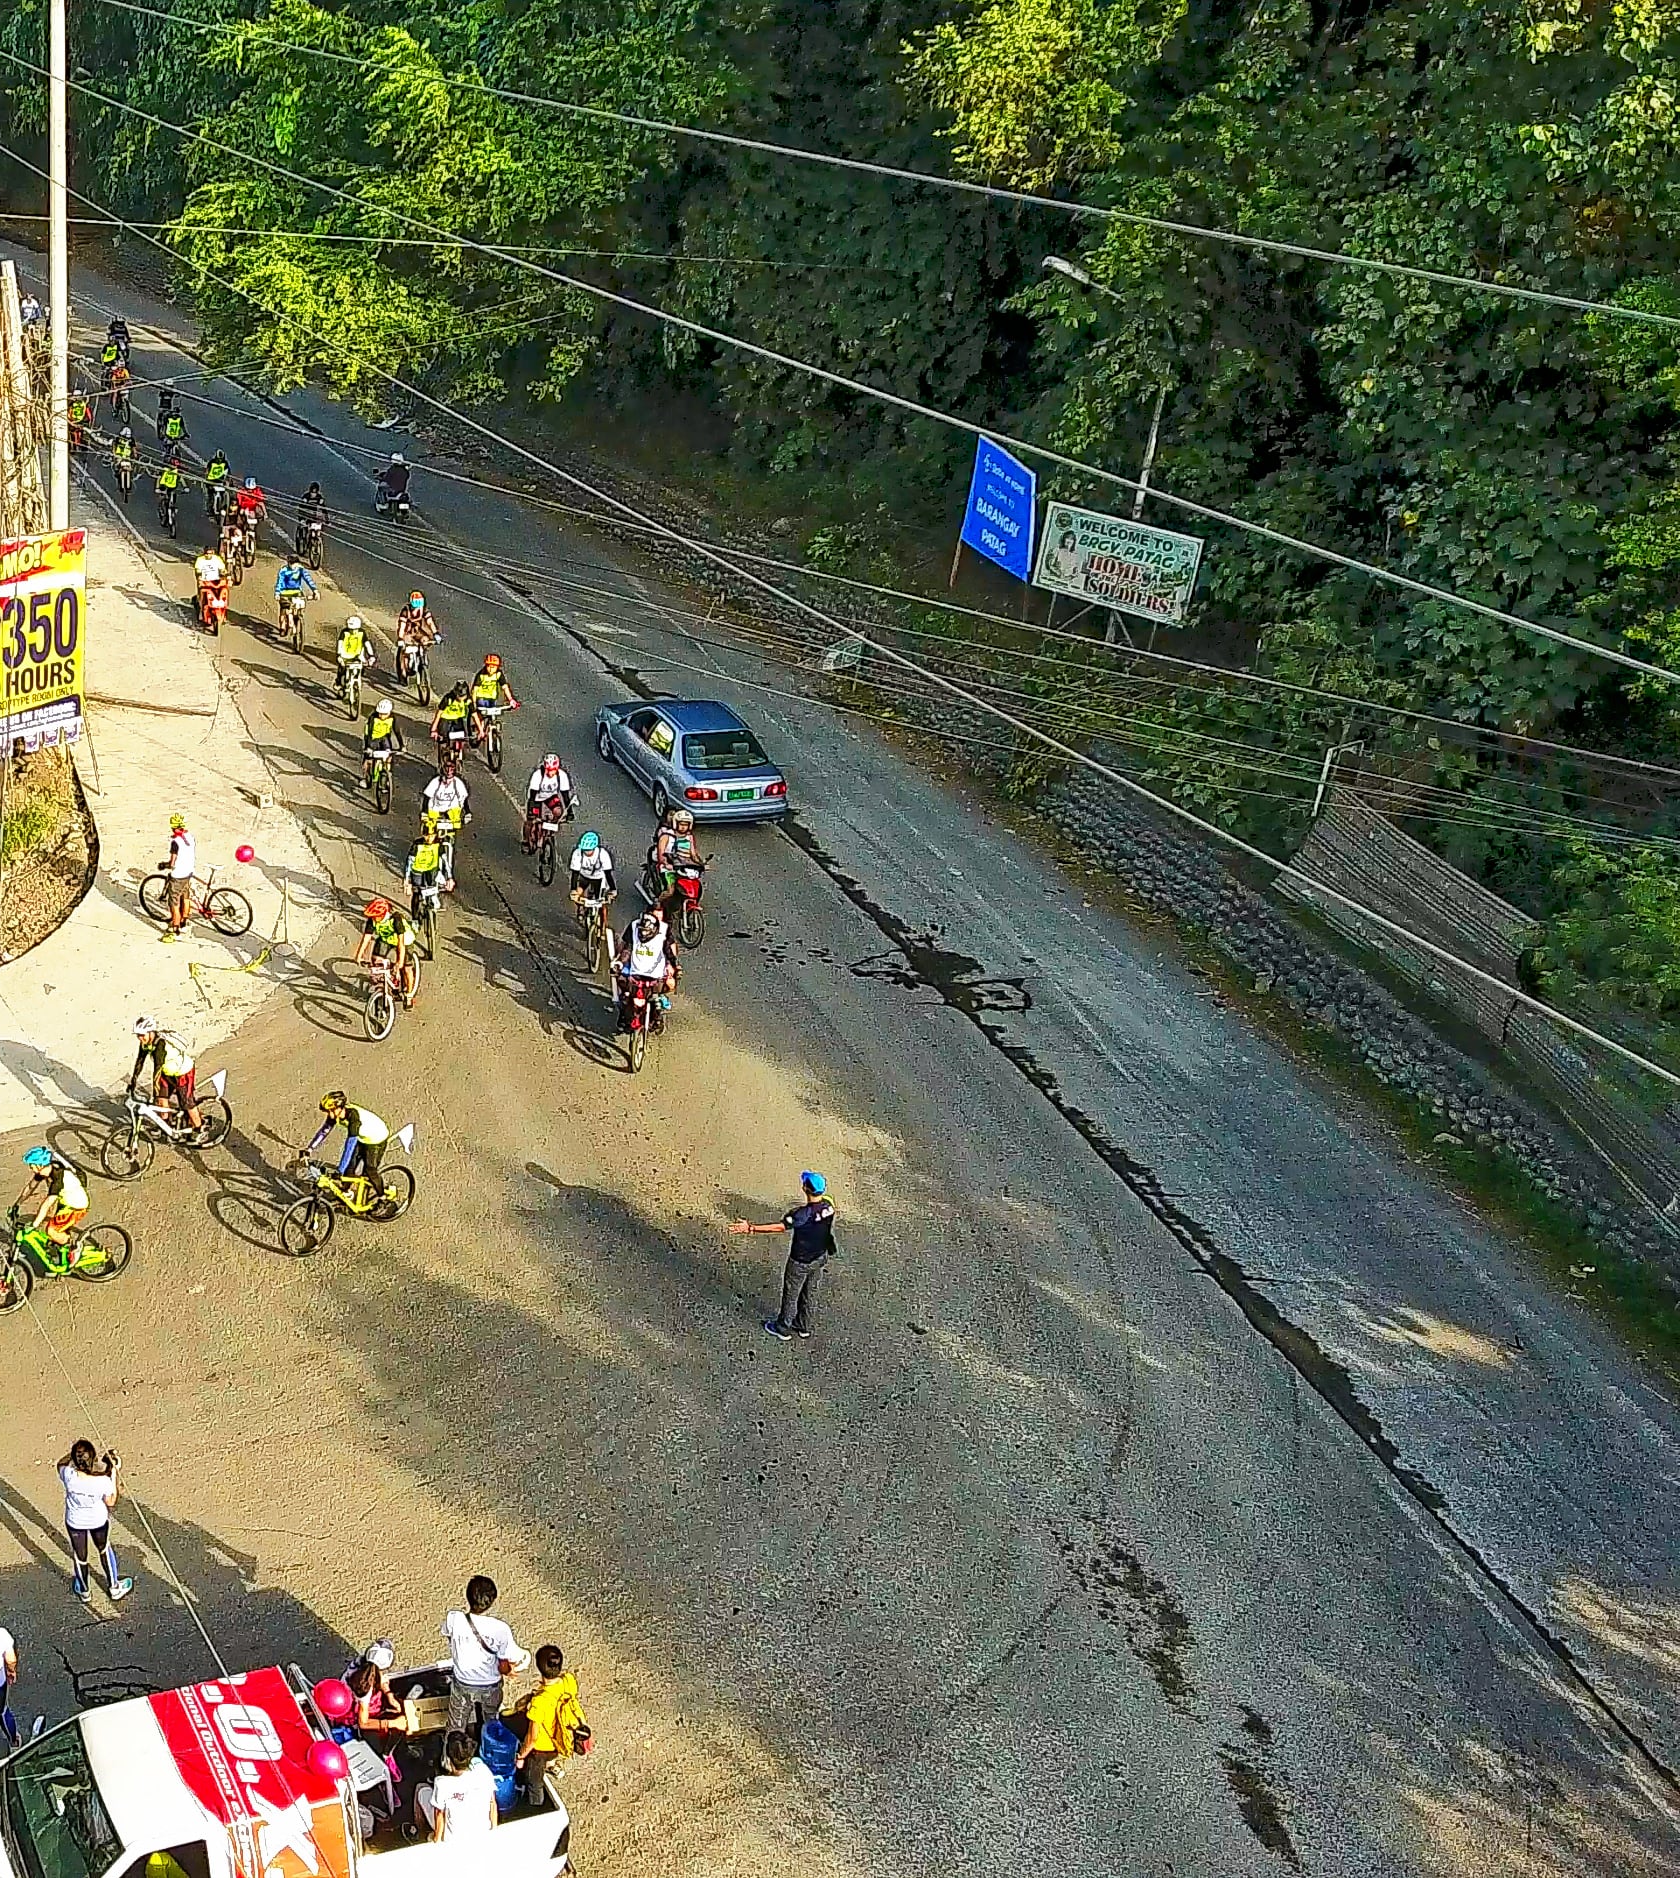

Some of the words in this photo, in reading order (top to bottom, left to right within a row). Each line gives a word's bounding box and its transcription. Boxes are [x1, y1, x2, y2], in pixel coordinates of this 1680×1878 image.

[976, 496, 1022, 538] BARANGAY
[980, 528, 1008, 557] PATAG
[1078, 518, 1150, 547] WELCOME
[1152, 537, 1174, 552] TO
[1078, 534, 1121, 556] BRGY.
[1124, 546, 1175, 569] PATAG
[1088, 553, 1143, 581] HOME
[5, 659, 76, 699] HOURS
[199, 1729, 235, 1799] Outdoor
